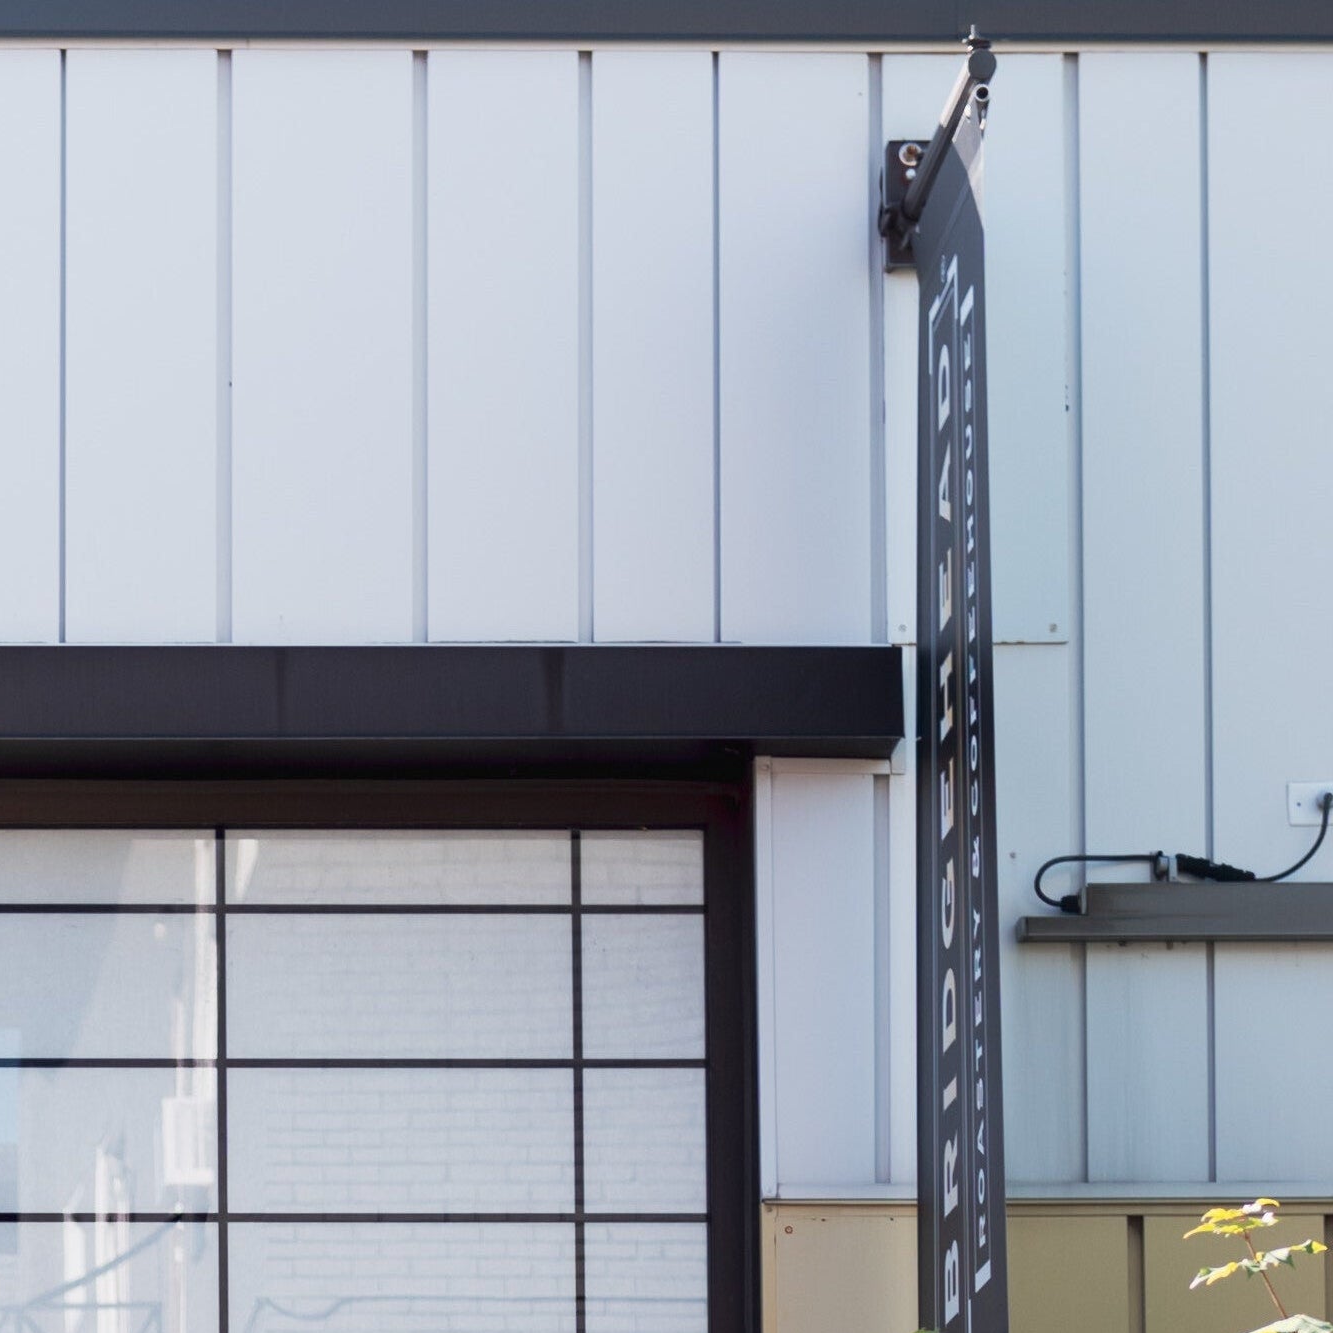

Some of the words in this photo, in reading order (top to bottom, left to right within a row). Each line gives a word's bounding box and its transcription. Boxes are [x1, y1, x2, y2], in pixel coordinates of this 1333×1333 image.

[963, 333, 980, 818] COFFEEHOUSE
[937, 343, 961, 1328] BRIDGEHEAD
[970, 835, 980, 879] &
[973, 906, 987, 1249] ROASTERY
